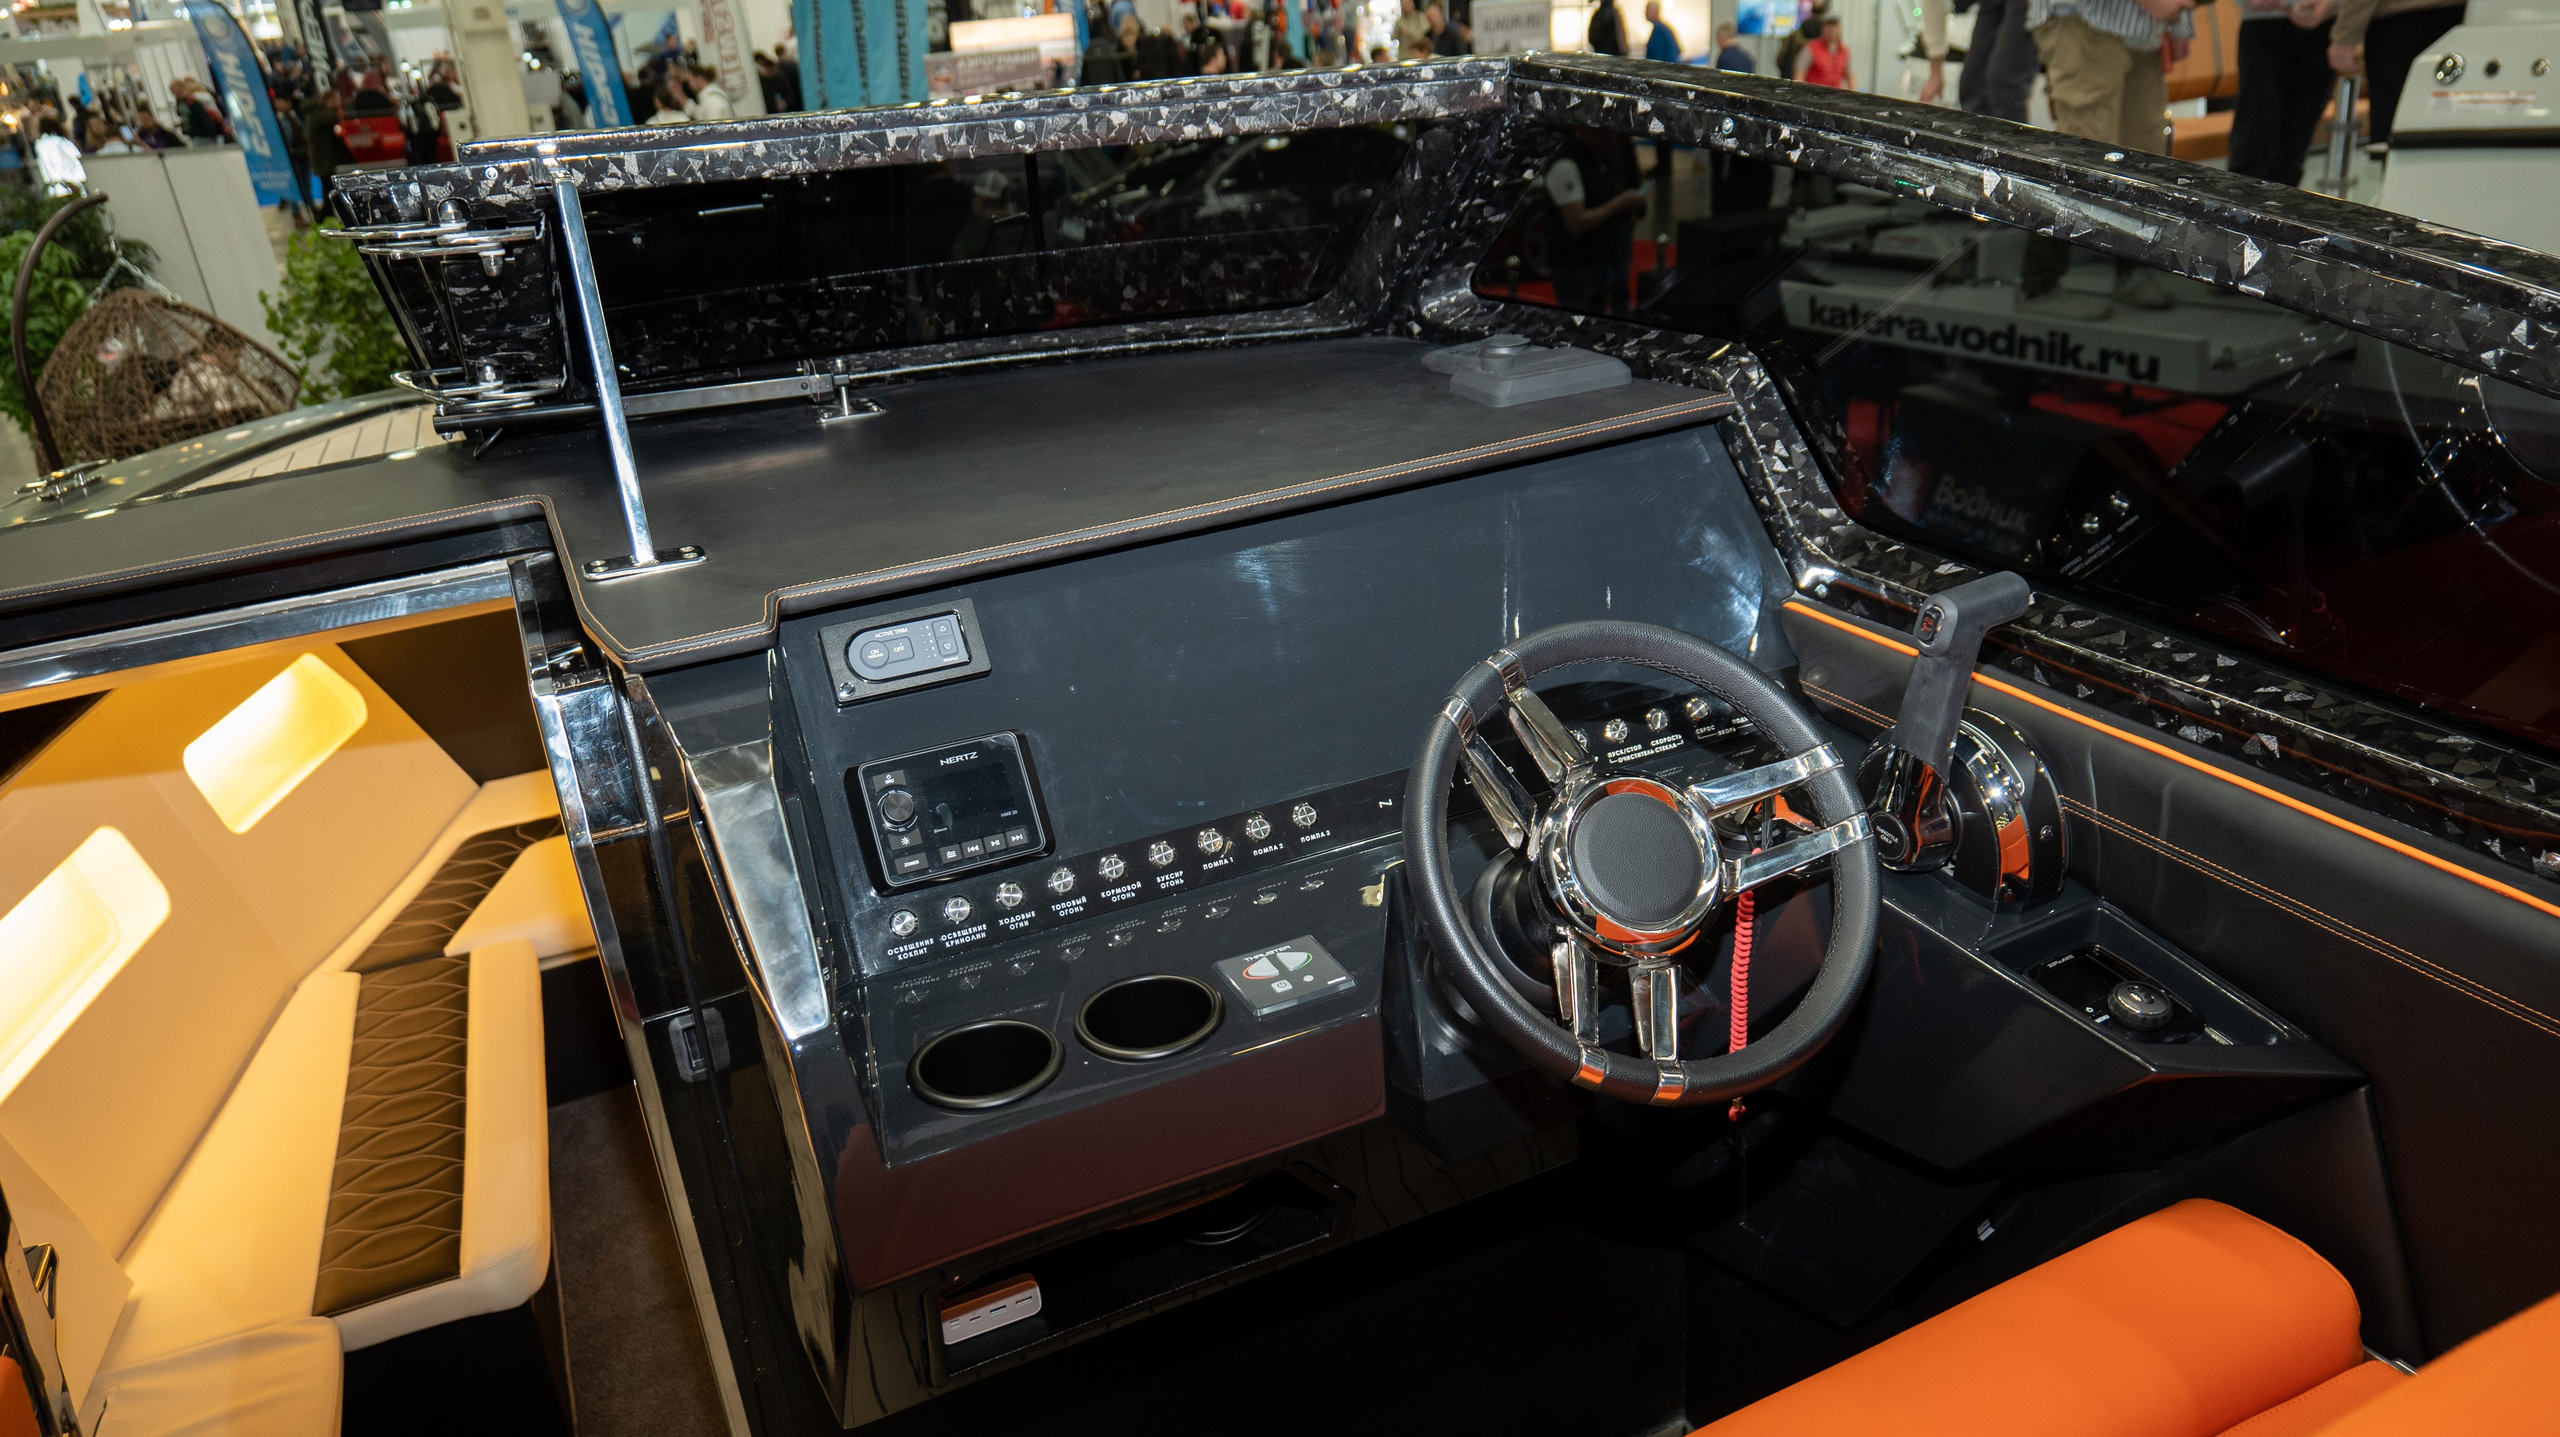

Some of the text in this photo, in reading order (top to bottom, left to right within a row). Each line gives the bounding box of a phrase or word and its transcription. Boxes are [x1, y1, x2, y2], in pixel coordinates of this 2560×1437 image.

[875, 627, 908, 639] ACTIVE TRIM
[1651, 734, 1682, 747] СКОРОСТЬ
[1607, 744, 1642, 758] ПУСК/СТОП
[1618, 742, 1677, 763] ОЧИСТИТЕЛЬ СТЕКЛА
[939, 751, 979, 766] HERTZ
[1300, 832, 1325, 843] ПОМПА
[1876, 825, 1899, 843] THROTTLE
[1880, 834, 1893, 845] ONLY
[1253, 845, 1278, 857] ПОМПА
[1203, 858, 1230, 870] ПОМПА
[1156, 870, 1184, 883] БУКСИР
[1160, 878, 1184, 889] ОГОНЬ
[1100, 881, 1142, 898] КОРМОВОЙ
[1051, 896, 1087, 911] ТОПОВЫЙ
[1111, 892, 1136, 902] ОГОНЬ
[998, 910, 1036, 926] ХОДОВЫЕ
[1059, 906, 1084, 917] ОГОНЬ
[941, 923, 987, 941] ОСВЕЩЕНИЕ
[1009, 920, 1030, 930] ОГНИ
[887, 938, 934, 956] ОСВЕЩЕНИЕ
[945, 932, 986, 948] КРИНОЛИН
[897, 947, 928, 961] КОКПИТ
[1243, 945, 1291, 962] THRUSTER
